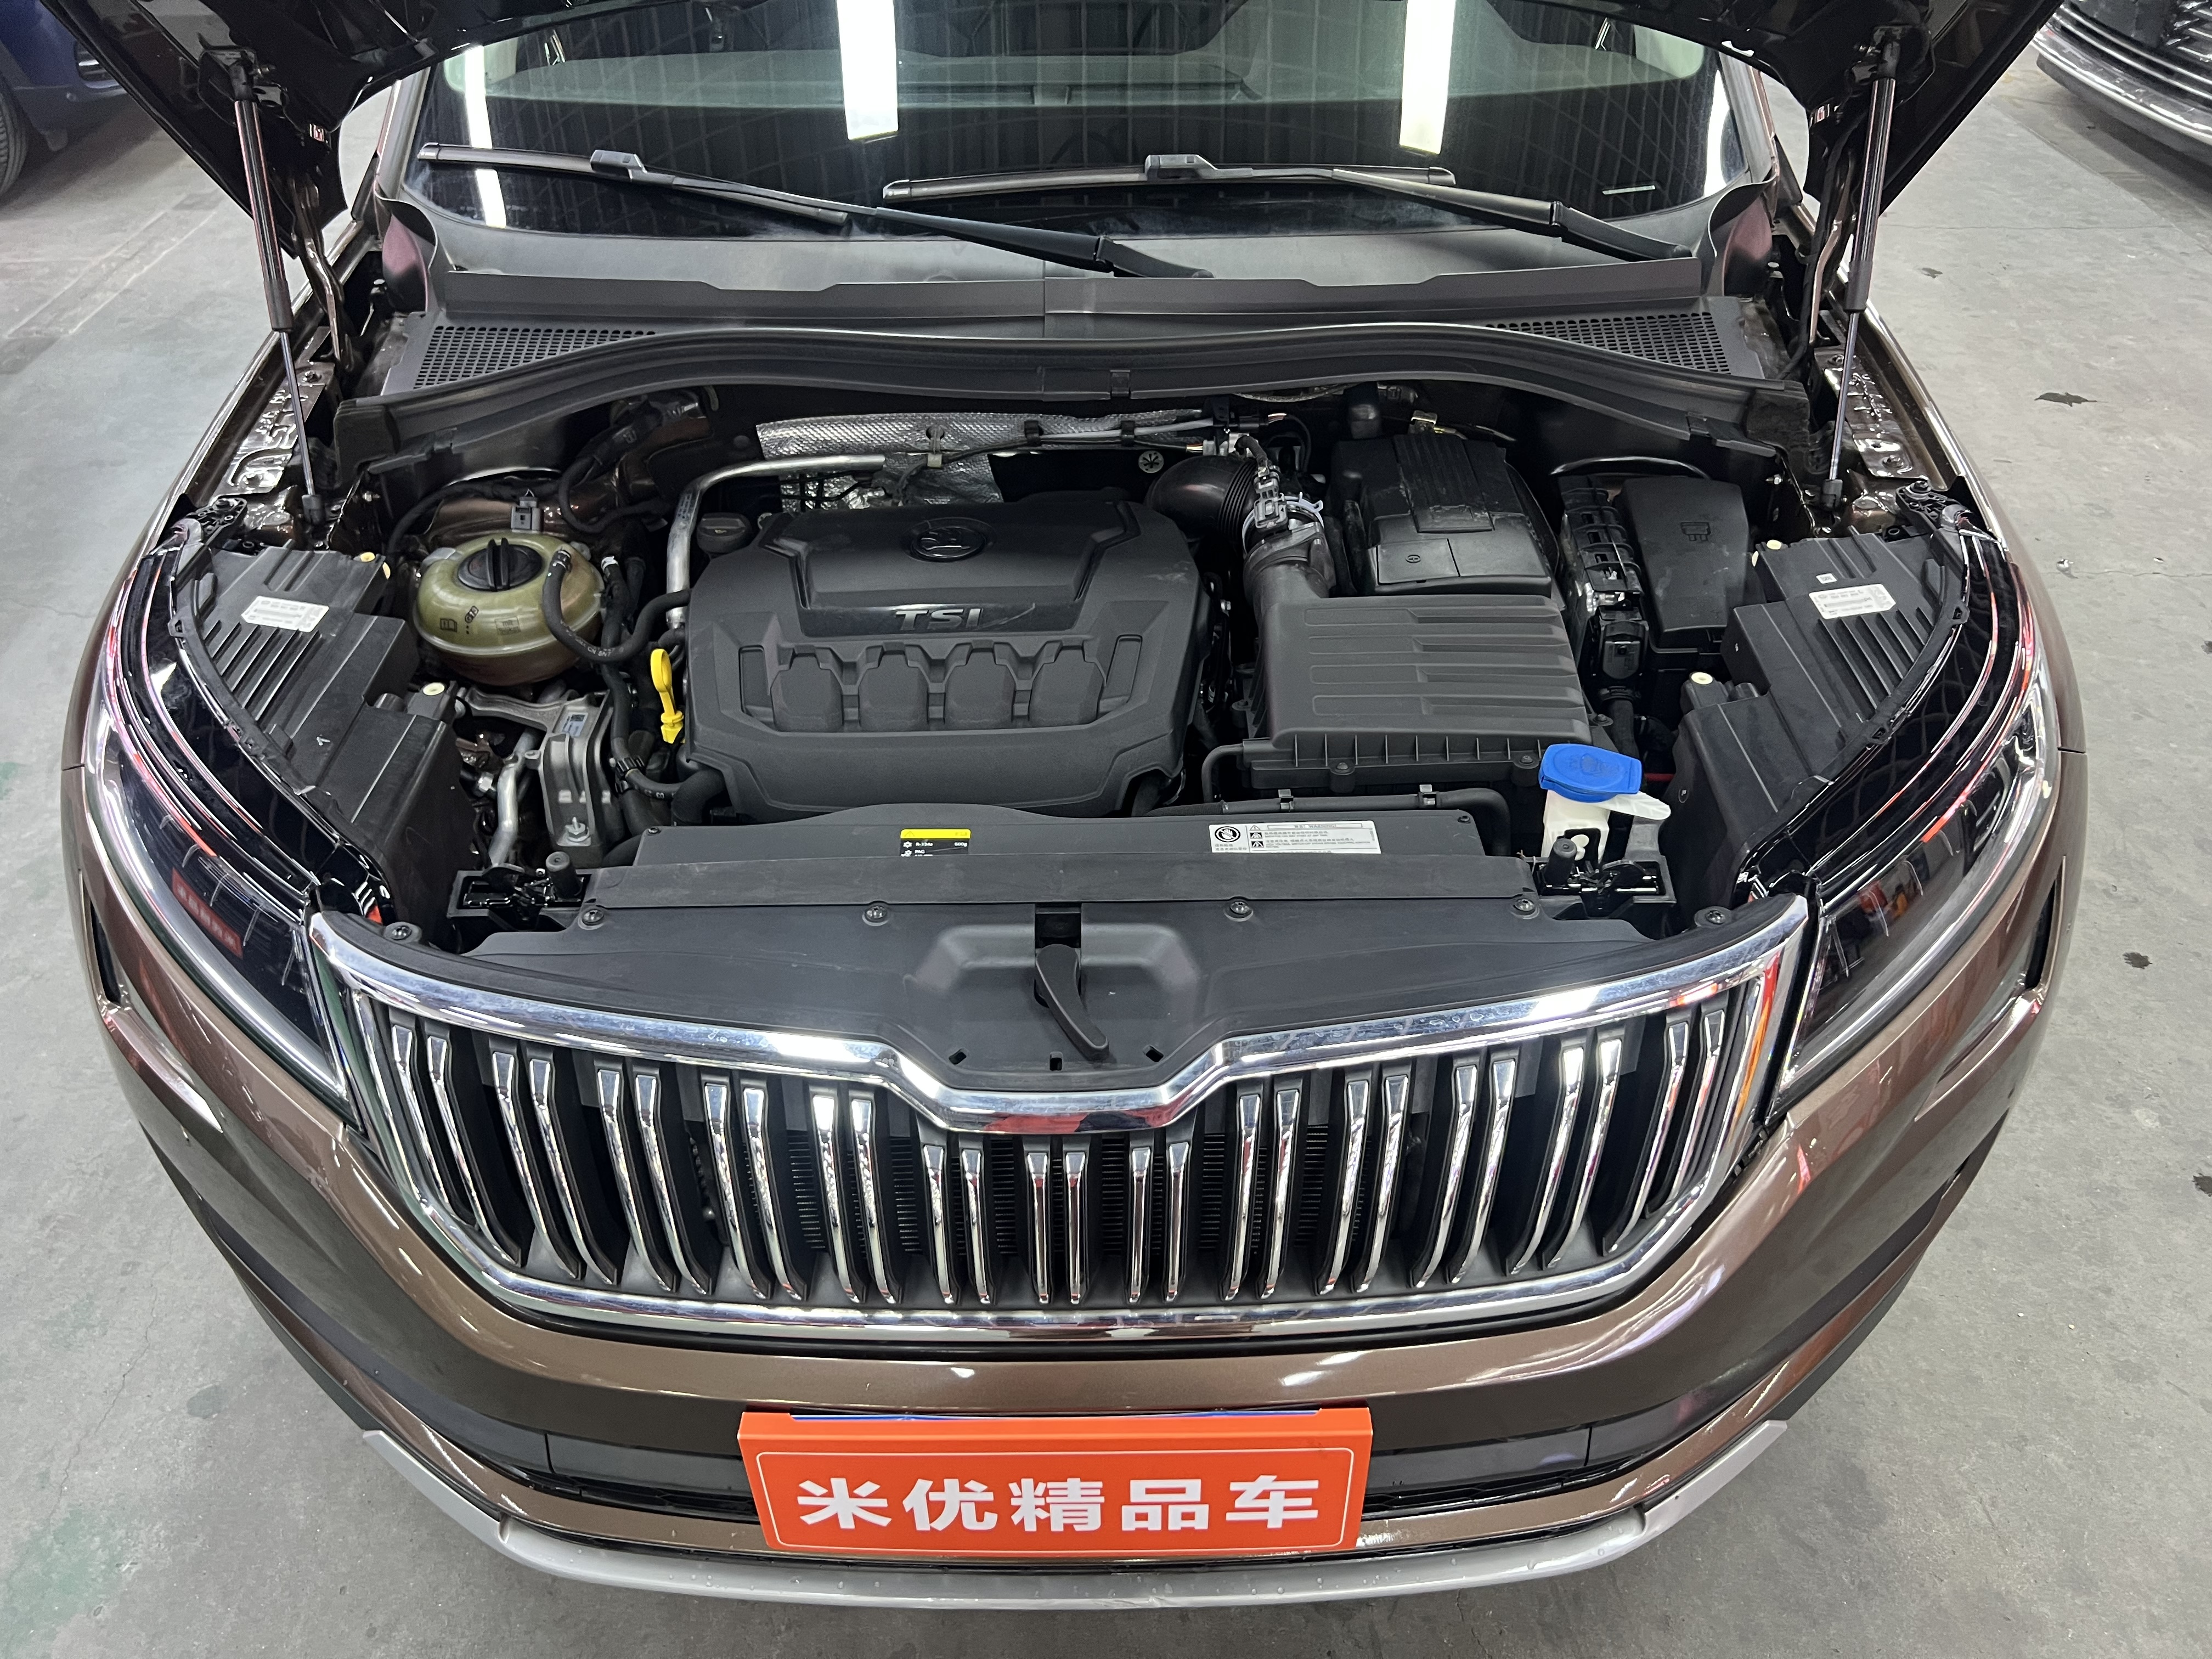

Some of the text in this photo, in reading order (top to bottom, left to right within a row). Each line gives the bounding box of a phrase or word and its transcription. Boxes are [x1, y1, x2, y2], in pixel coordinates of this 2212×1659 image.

[895, 608, 983, 630] TSI
[797, 1475, 1318, 1532] 米优精品车
